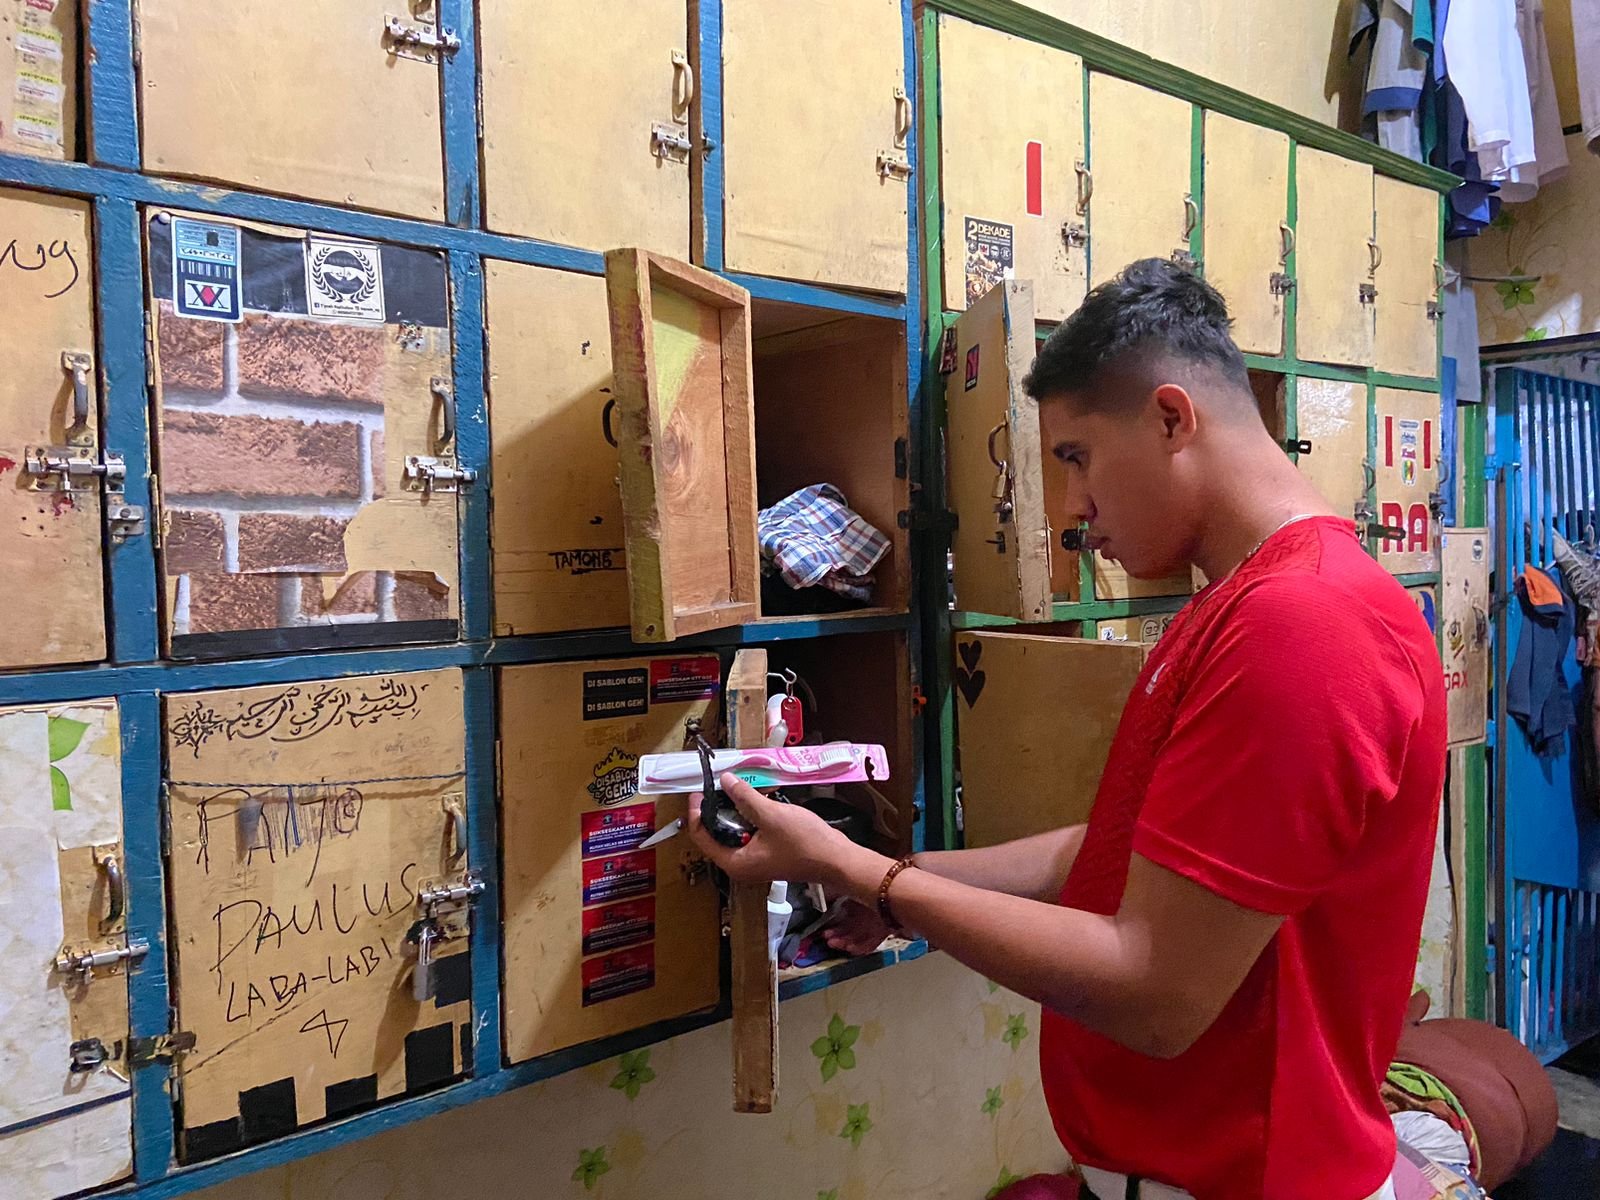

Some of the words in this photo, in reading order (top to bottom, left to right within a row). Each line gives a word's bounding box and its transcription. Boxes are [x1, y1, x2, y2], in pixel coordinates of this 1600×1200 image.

[967, 220, 978, 241] 2
[977, 223, 1011, 239] DEKADE
[587, 680, 596, 688] DI
[596, 677, 626, 688] SABLON
[627, 676, 645, 685] GEH!
[587, 703, 596, 712] DI
[596, 701, 626, 711] SABLON
[627, 698, 645, 707] GEH!
[605, 780, 631, 799] GEH!
[209, 863, 416, 996] PAULUS
[226, 937, 393, 1023] LABA-LABI
